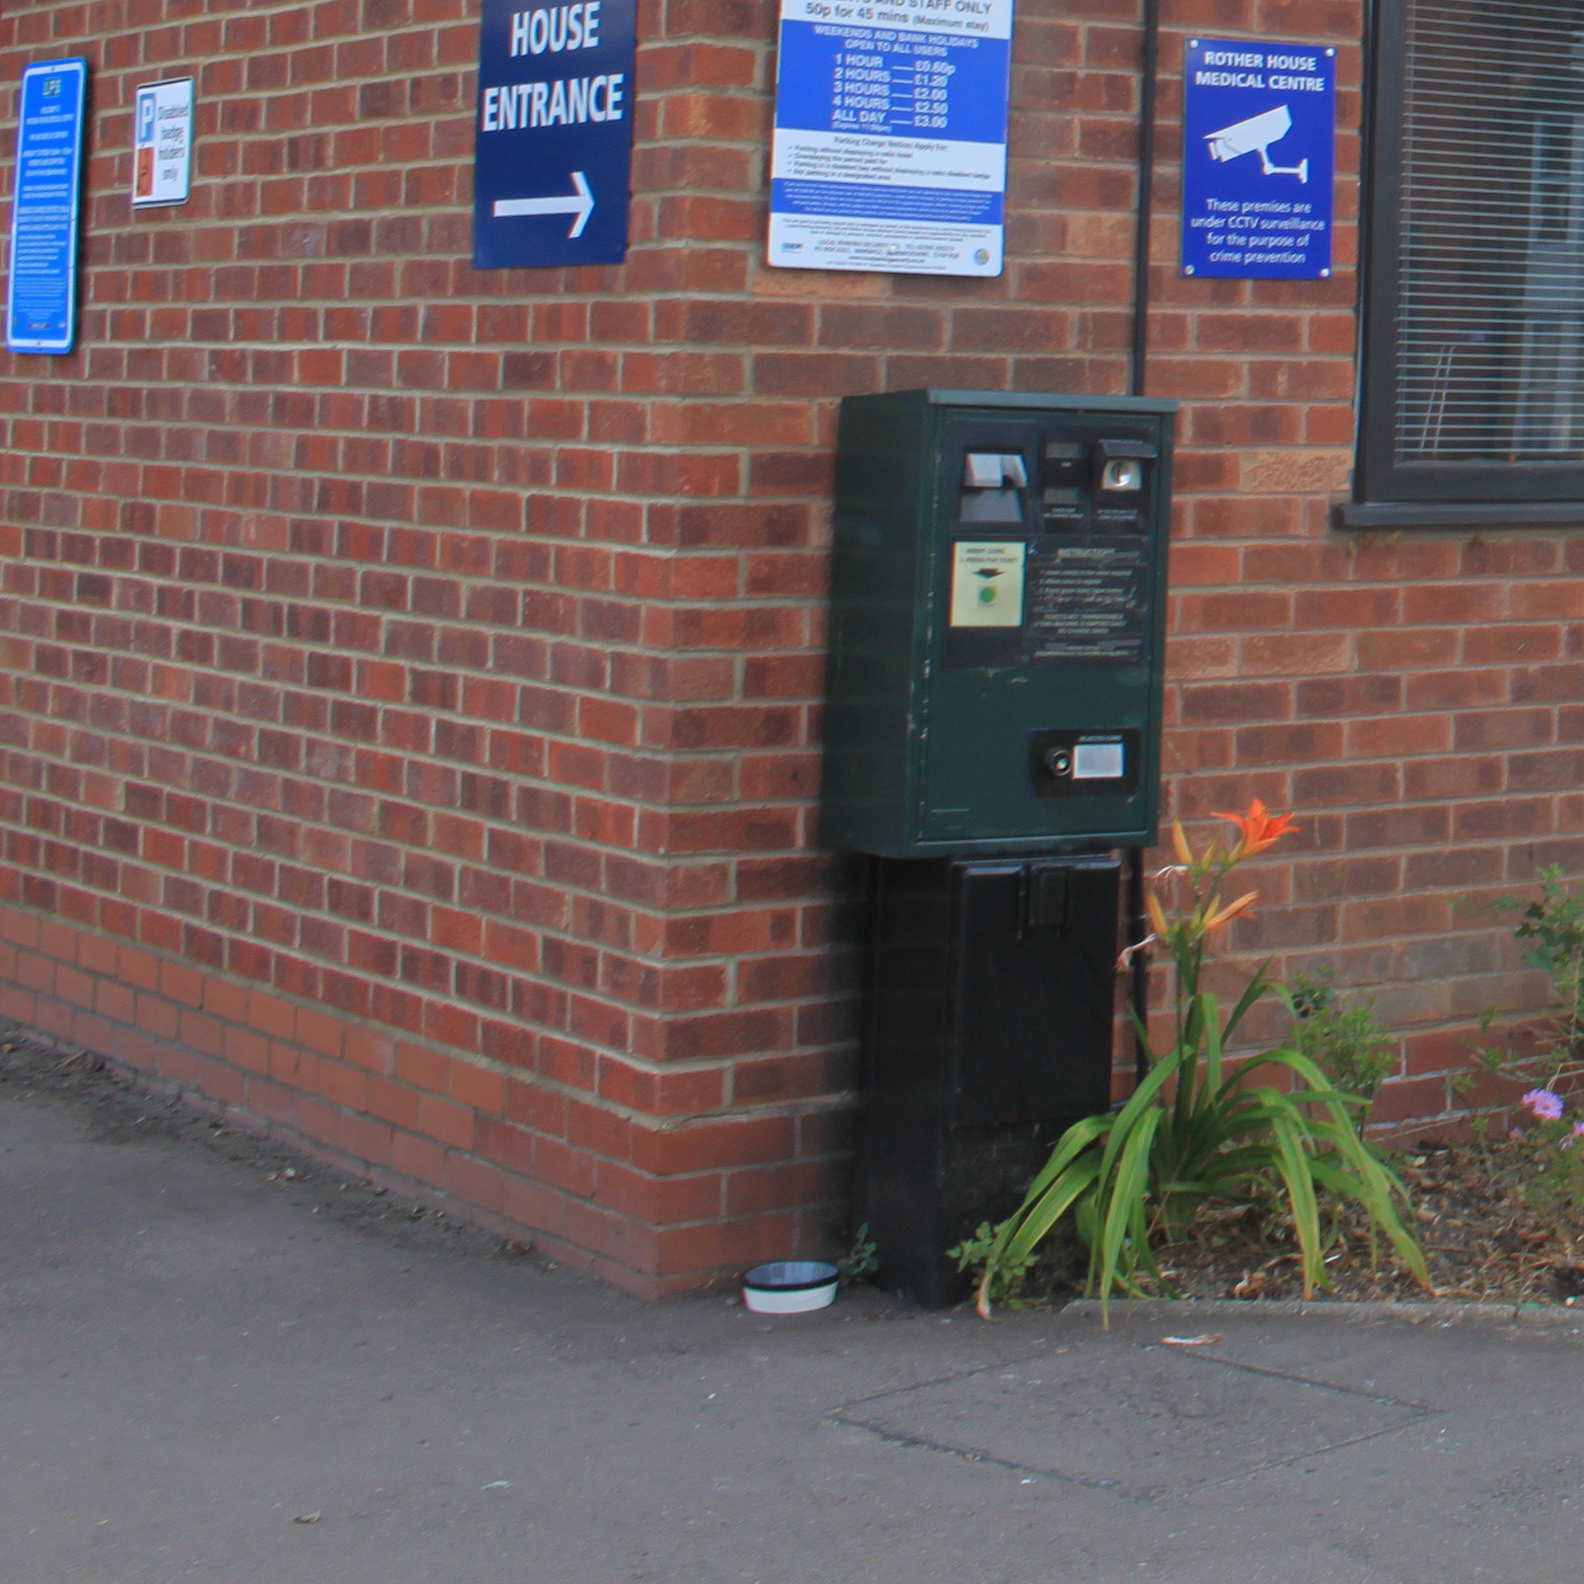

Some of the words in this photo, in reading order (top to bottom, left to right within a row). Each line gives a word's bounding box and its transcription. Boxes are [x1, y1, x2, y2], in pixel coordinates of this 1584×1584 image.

[955, 0, 992, 14] ONLY
[806, 2, 831, 17] 50p
[834, 4, 854, 17] for
[857, 6, 873, 20] 45
[877, 9, 908, 23] mins
[912, 14, 963, 28] (Maximum
[966, 19, 990, 32] stay)
[510, 1, 601, 57] HOUSE
[814, 25, 873, 40] WEEKENDS
[874, 30, 896, 41] AND
[899, 32, 926, 43] BANK
[928, 34, 979, 49] HOLIDAYS
[845, 39, 874, 51] OPEN
[877, 41, 891, 52] TO
[892, 42, 912, 54] ALL
[914, 44, 948, 57] USERS
[834, 54, 841, 65] 1
[846, 54, 884, 67] HOUR
[1204, 51, 1263, 68] ROTHER
[1267, 55, 1316, 71] HOUSE
[834, 67, 842, 79] 2
[845, 68, 891, 82] HOURS
[1195, 71, 1265, 88] MEDICAL
[1268, 75, 1325, 91] CENTRE
[833, 81, 842, 93] 3
[844, 82, 890, 96] HOURS
[482, 73, 624, 132] ENTRANCE
[833, 94, 842, 106] 4
[844, 96, 890, 110] HOURS
[141, 99, 153, 140] P
[832, 109, 857, 122] ALL
[859, 111, 886, 124] DAY
[1206, 198, 1239, 211] These
[1242, 200, 1291, 214] premises
[1293, 203, 1312, 214] are
[1191, 216, 1226, 228] under
[1228, 216, 1260, 229] CCTV
[1261, 218, 1325, 230] surveillance
[1206, 232, 1224, 245] for
[1227, 233, 1247, 245] the
[1248, 235, 1295, 248] purpose
[1296, 233, 1310, 247] of
[1209, 250, 1242, 262] crime
[1244, 251, 1305, 265] prevention
